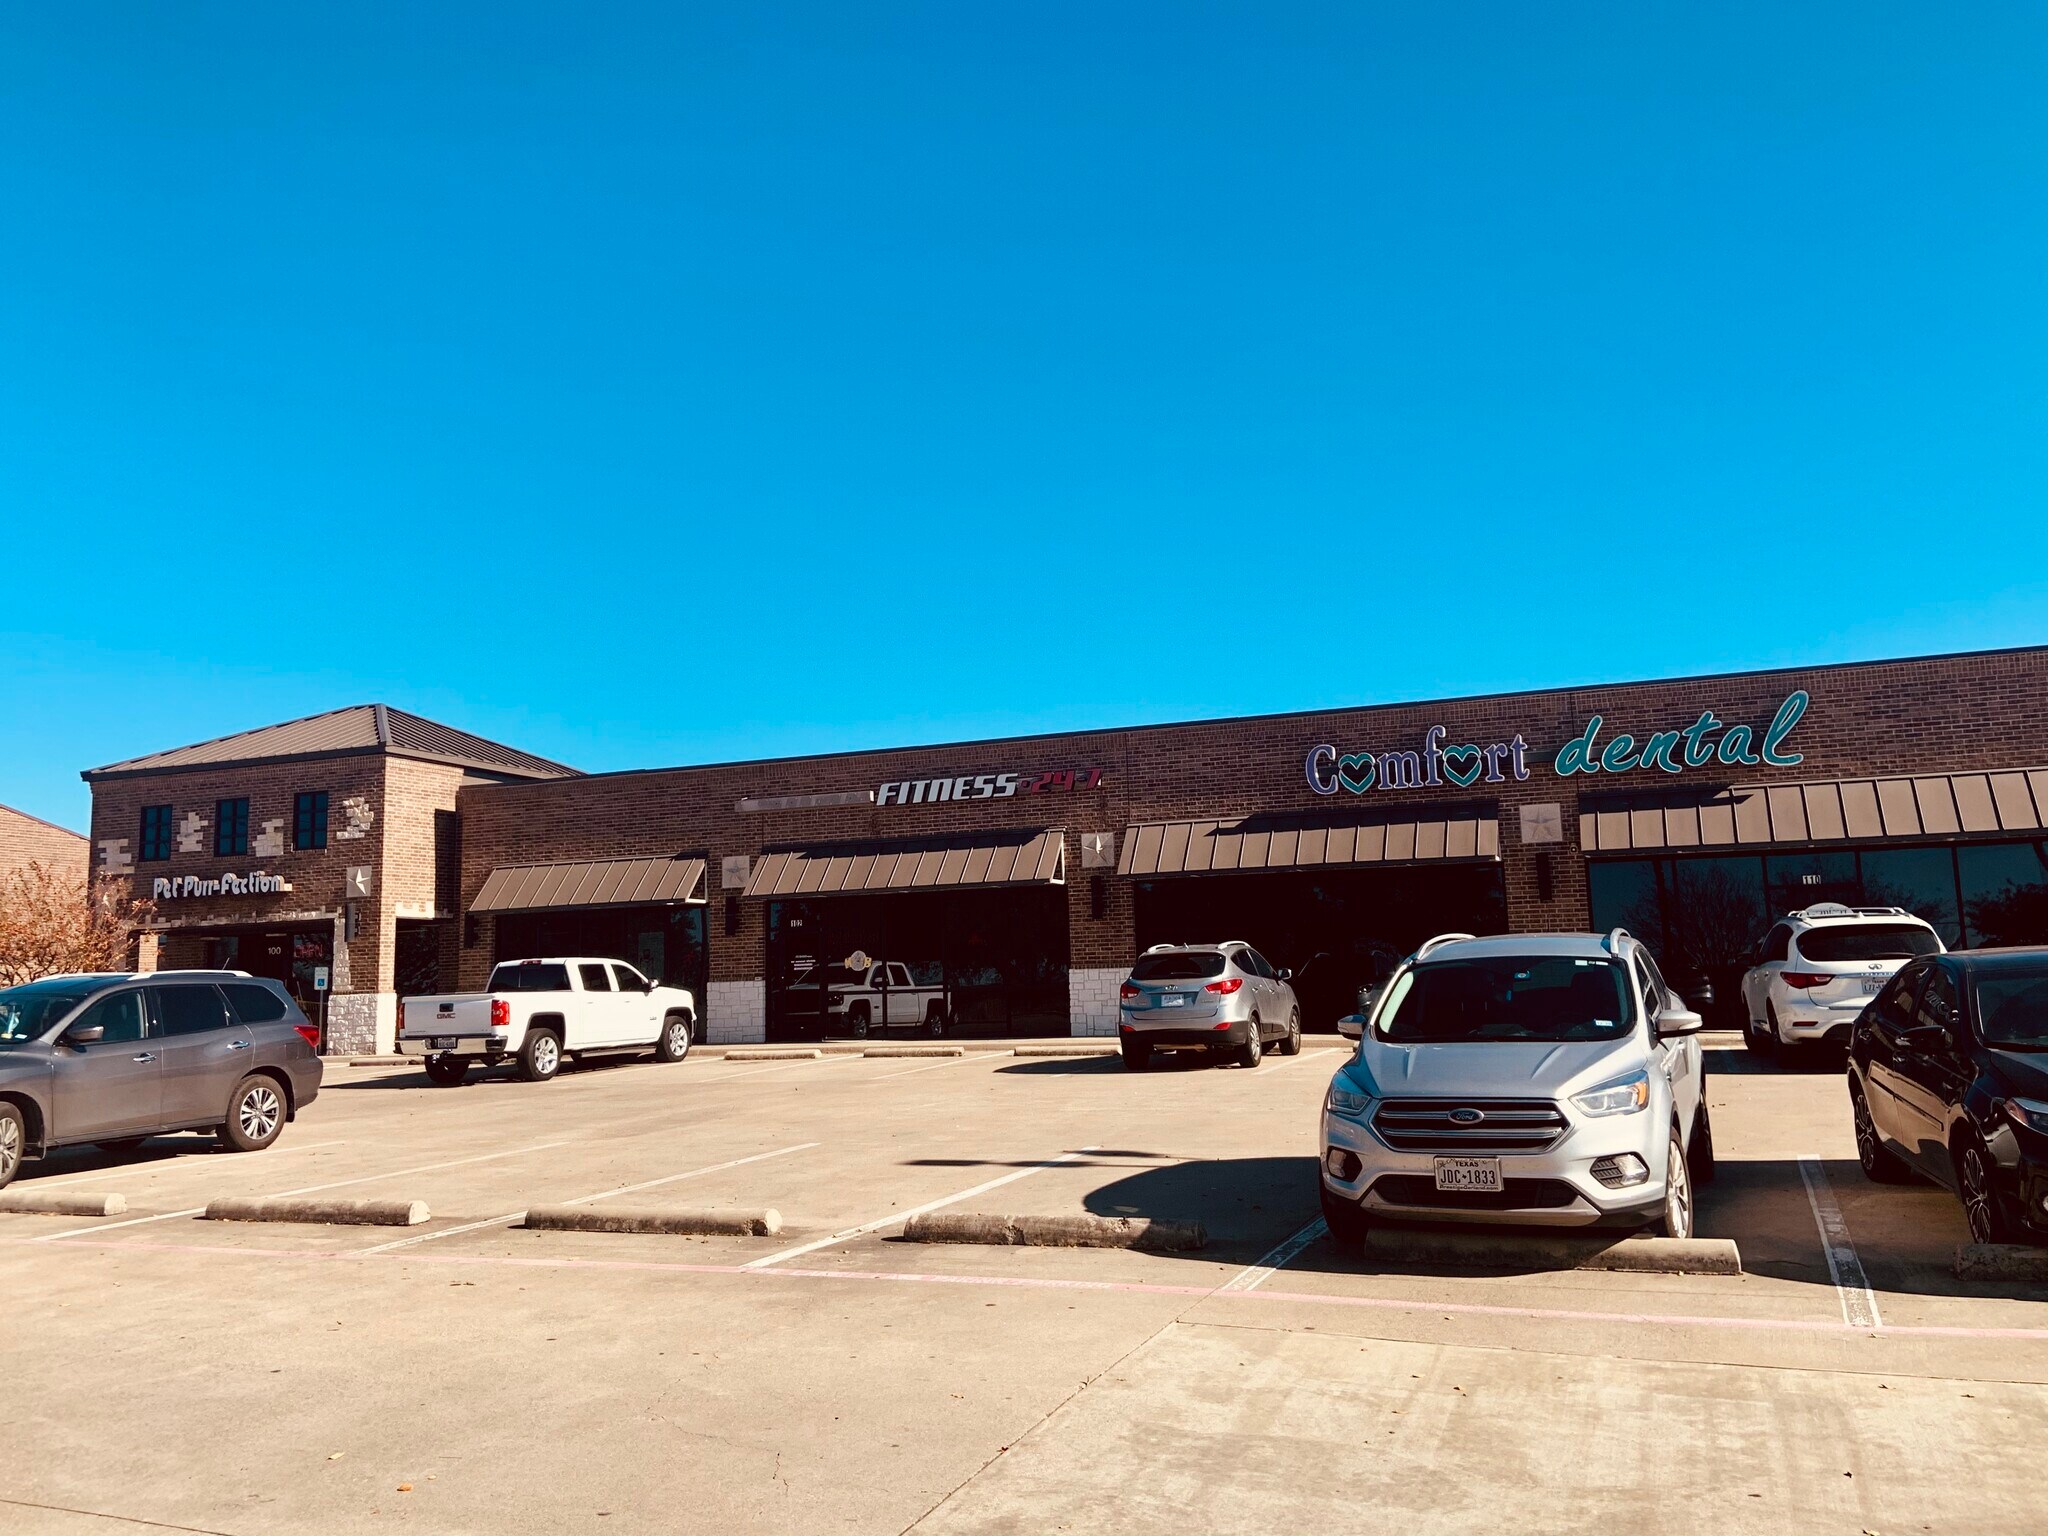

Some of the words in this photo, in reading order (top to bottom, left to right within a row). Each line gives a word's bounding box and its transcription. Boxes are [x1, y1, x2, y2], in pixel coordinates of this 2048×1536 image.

[1554, 689, 1809, 777] dental
[876, 773, 1019, 806] FITNESS
[1802, 874, 1821, 885] 110
[153, 877, 180, 899] Pet
[267, 946, 282, 955] 100
[436, 1012, 456, 1020] GMC
[1456, 1112, 1474, 1120] Ford
